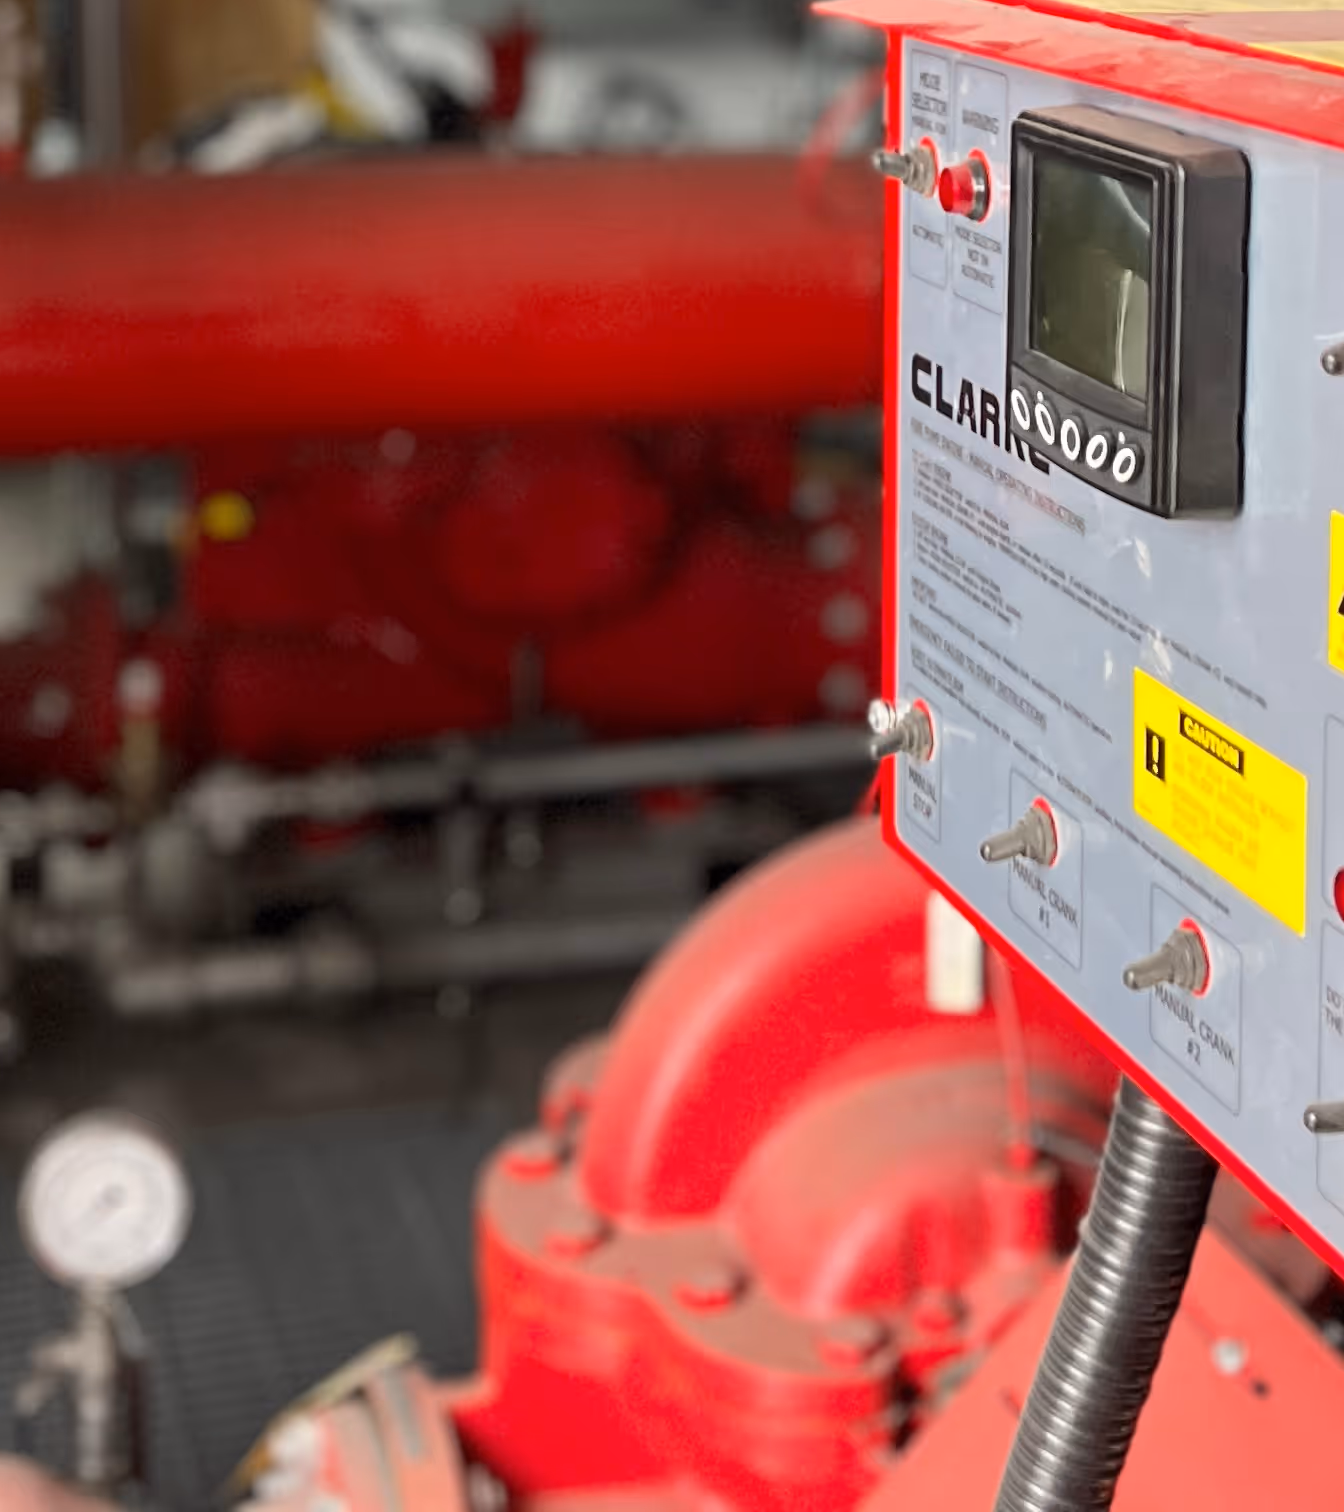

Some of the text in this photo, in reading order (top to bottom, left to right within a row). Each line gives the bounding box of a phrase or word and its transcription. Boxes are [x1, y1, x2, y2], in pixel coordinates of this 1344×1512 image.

[912, 92, 947, 117] SELECTOR
[1182, 714, 1242, 770] CAUTION
[909, 766, 937, 803] MANUAL
[1013, 857, 1078, 928] MANUAL CRANK
[1326, 986, 1341, 1008] DO
[1155, 984, 1234, 1065] MANUAL CRANK
[1325, 1006, 1343, 1035] THE
